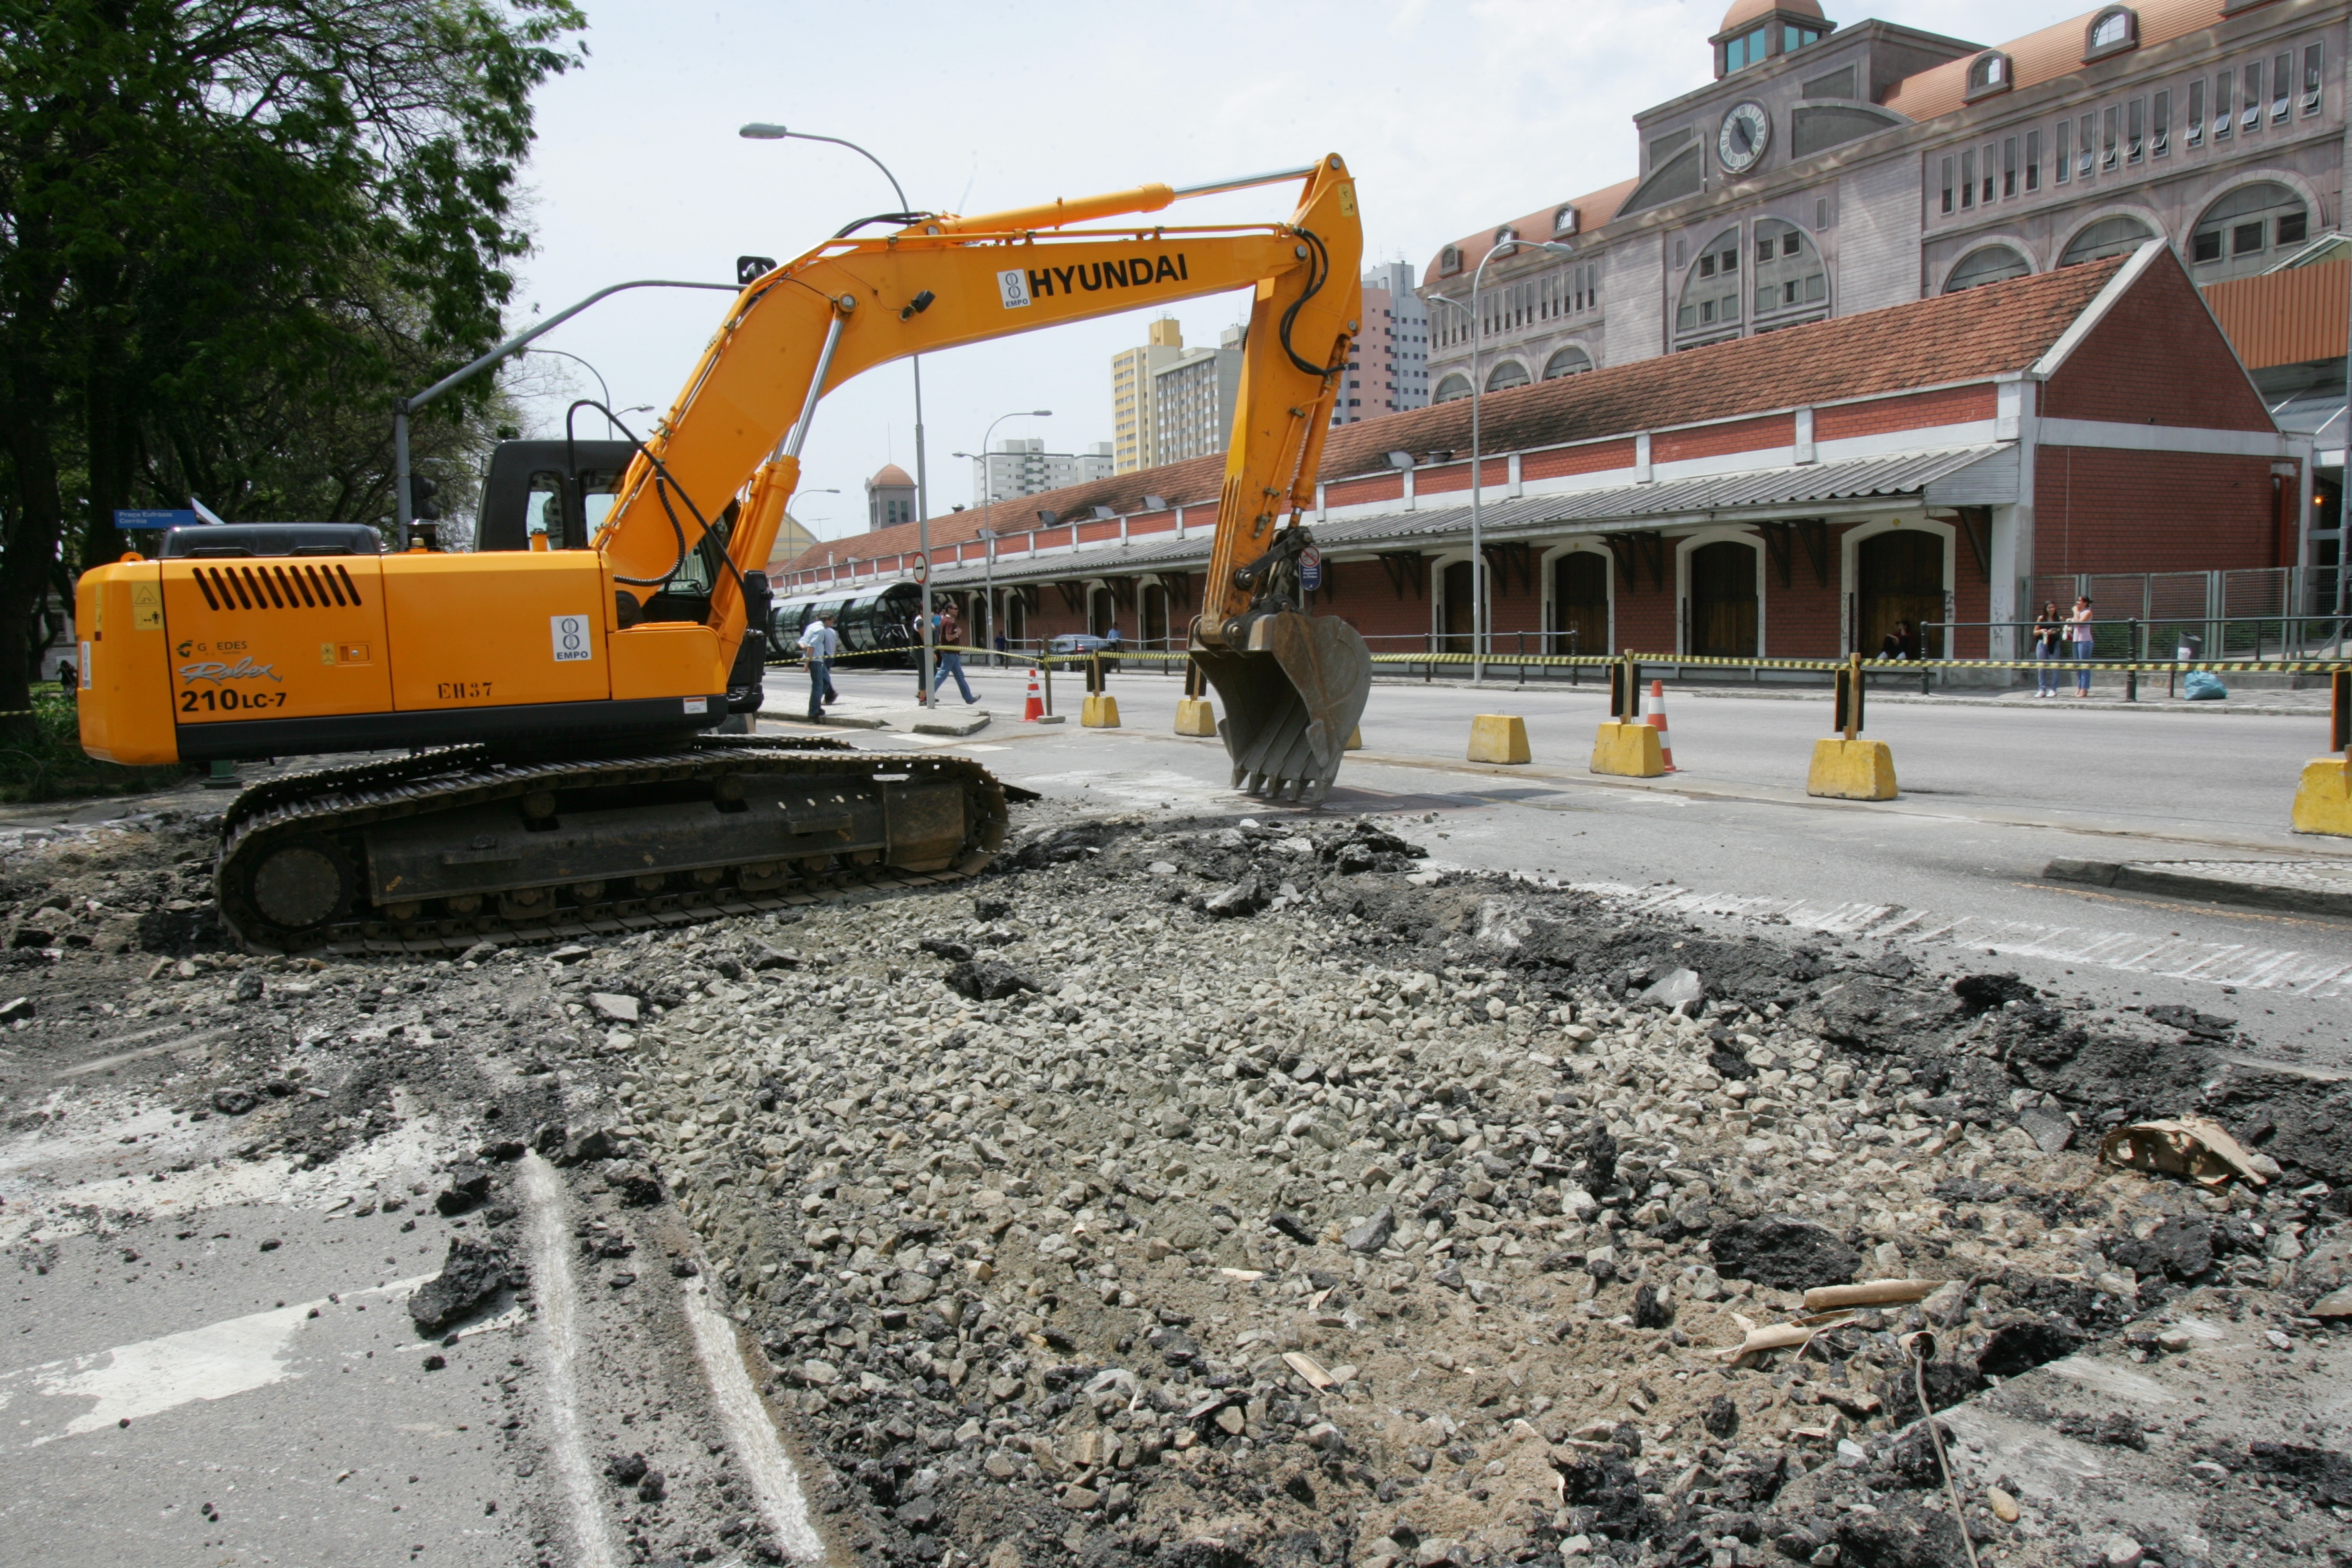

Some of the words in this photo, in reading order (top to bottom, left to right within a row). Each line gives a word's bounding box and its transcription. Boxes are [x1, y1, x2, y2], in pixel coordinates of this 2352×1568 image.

[1028, 254, 1188, 297] HYUNDAI
[1006, 299, 1028, 307] EMPO
[556, 651, 588, 660] EMPO
[179, 656, 283, 686] Robex
